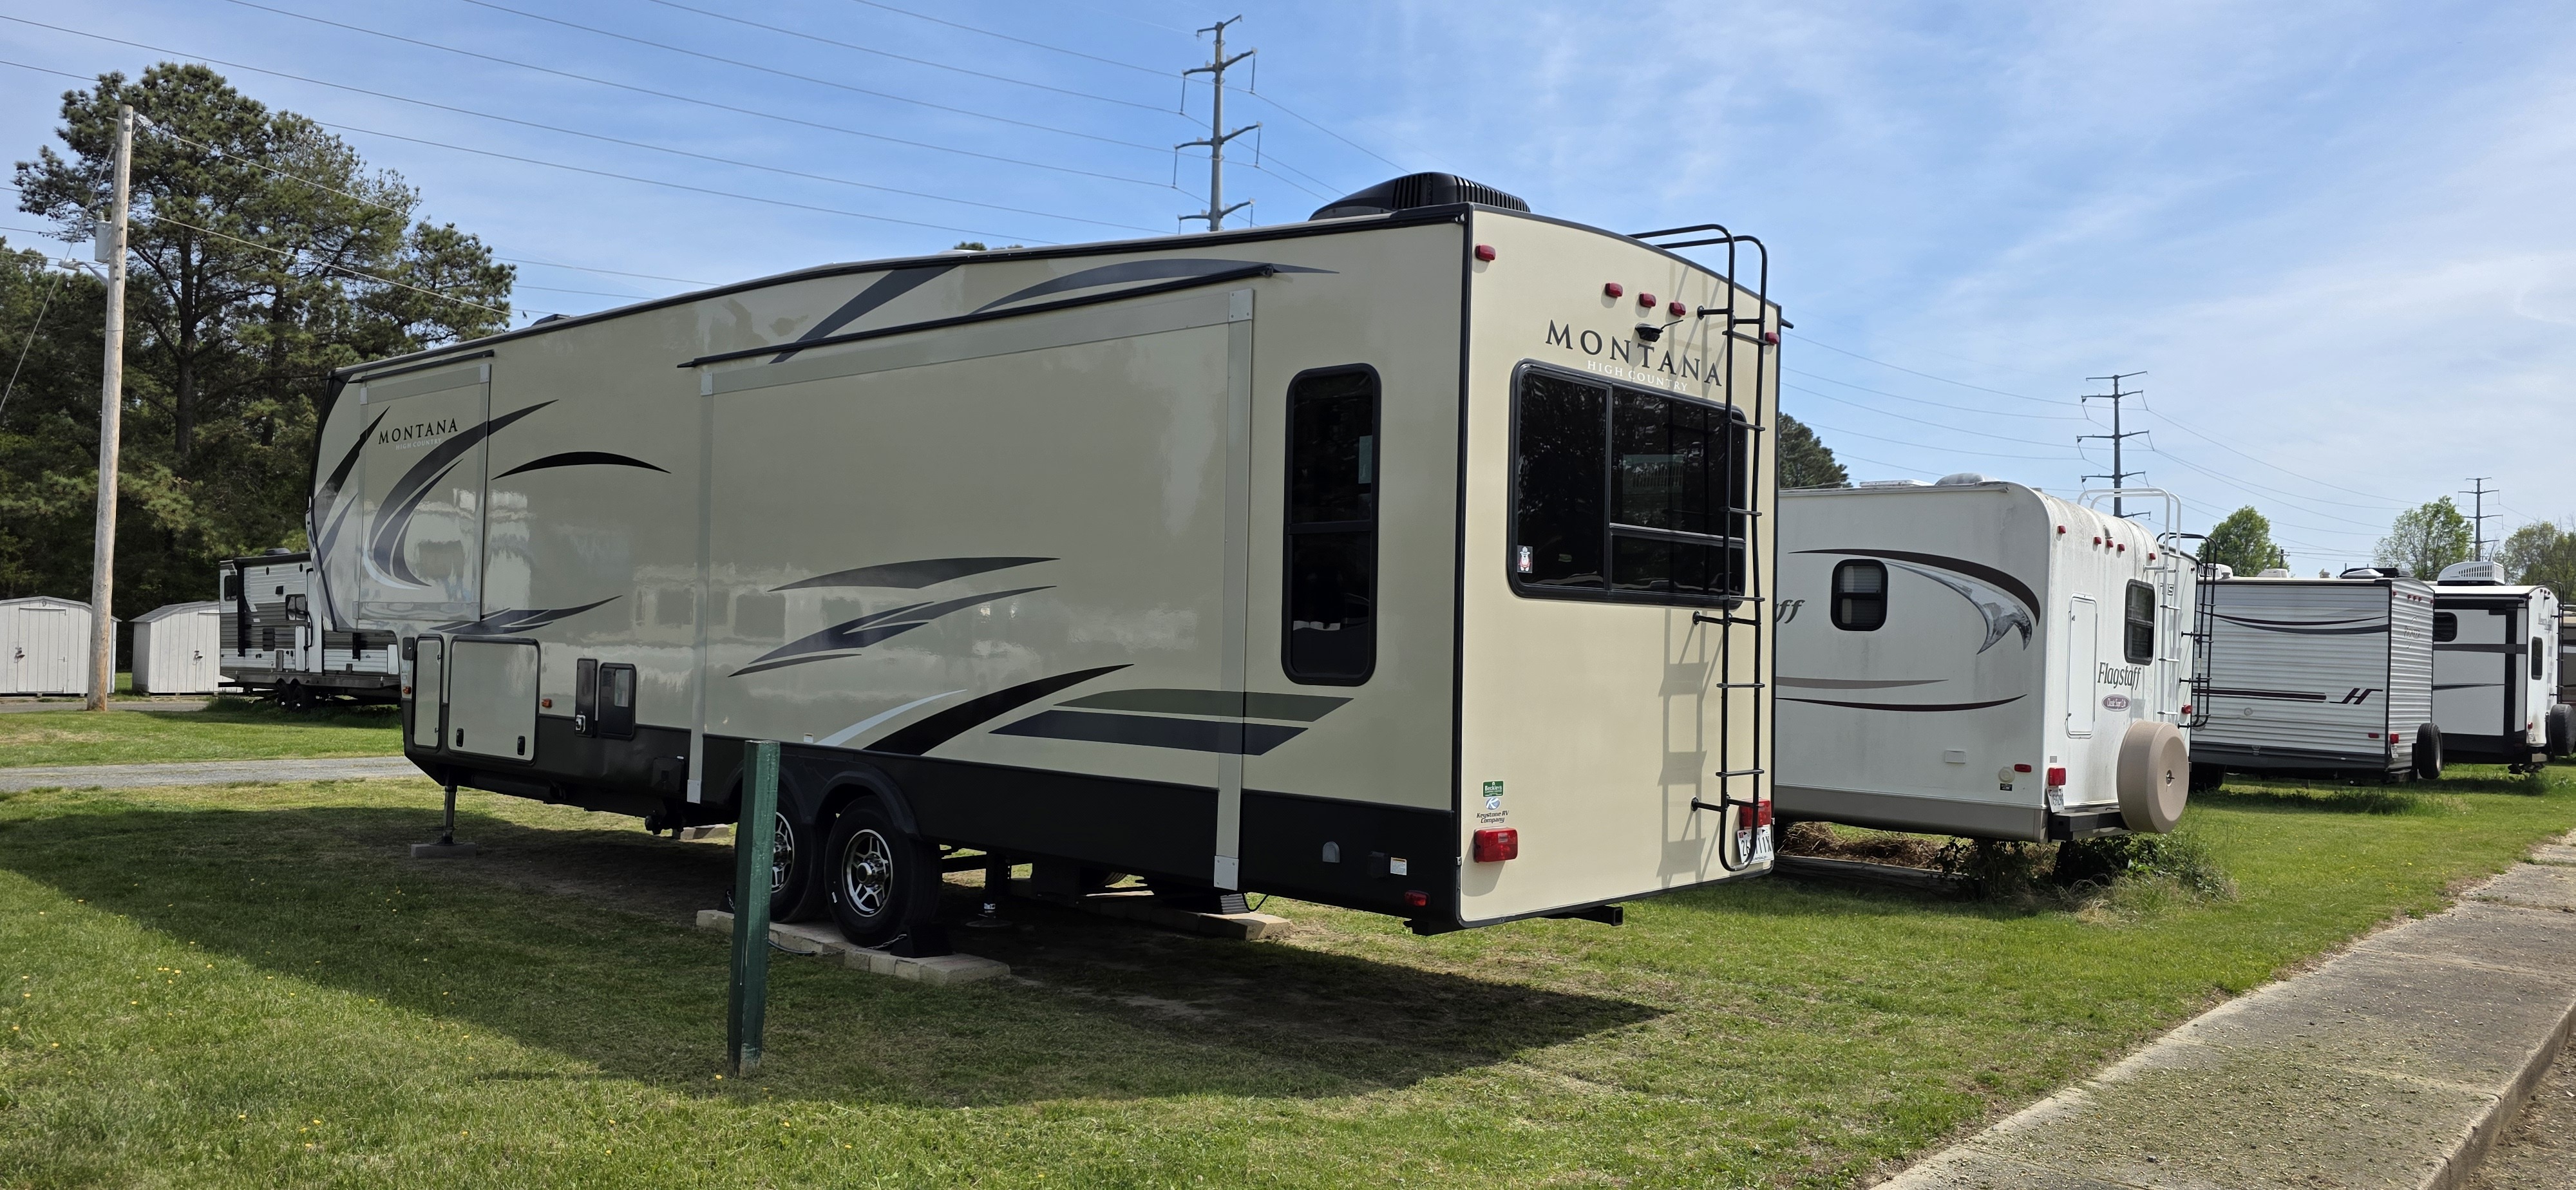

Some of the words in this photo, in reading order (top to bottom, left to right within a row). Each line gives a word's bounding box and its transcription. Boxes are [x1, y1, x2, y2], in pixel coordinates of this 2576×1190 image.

[1546, 319, 1722, 387] MONTANA
[1587, 360, 1624, 377] HIGH
[1628, 370, 1688, 392] COUNTRY
[378, 418, 458, 444] MONTANA
[395, 441, 412, 450] HIGH
[413, 438, 442, 448] COUNTRY
[2098, 662, 2142, 691] Flagstaff
